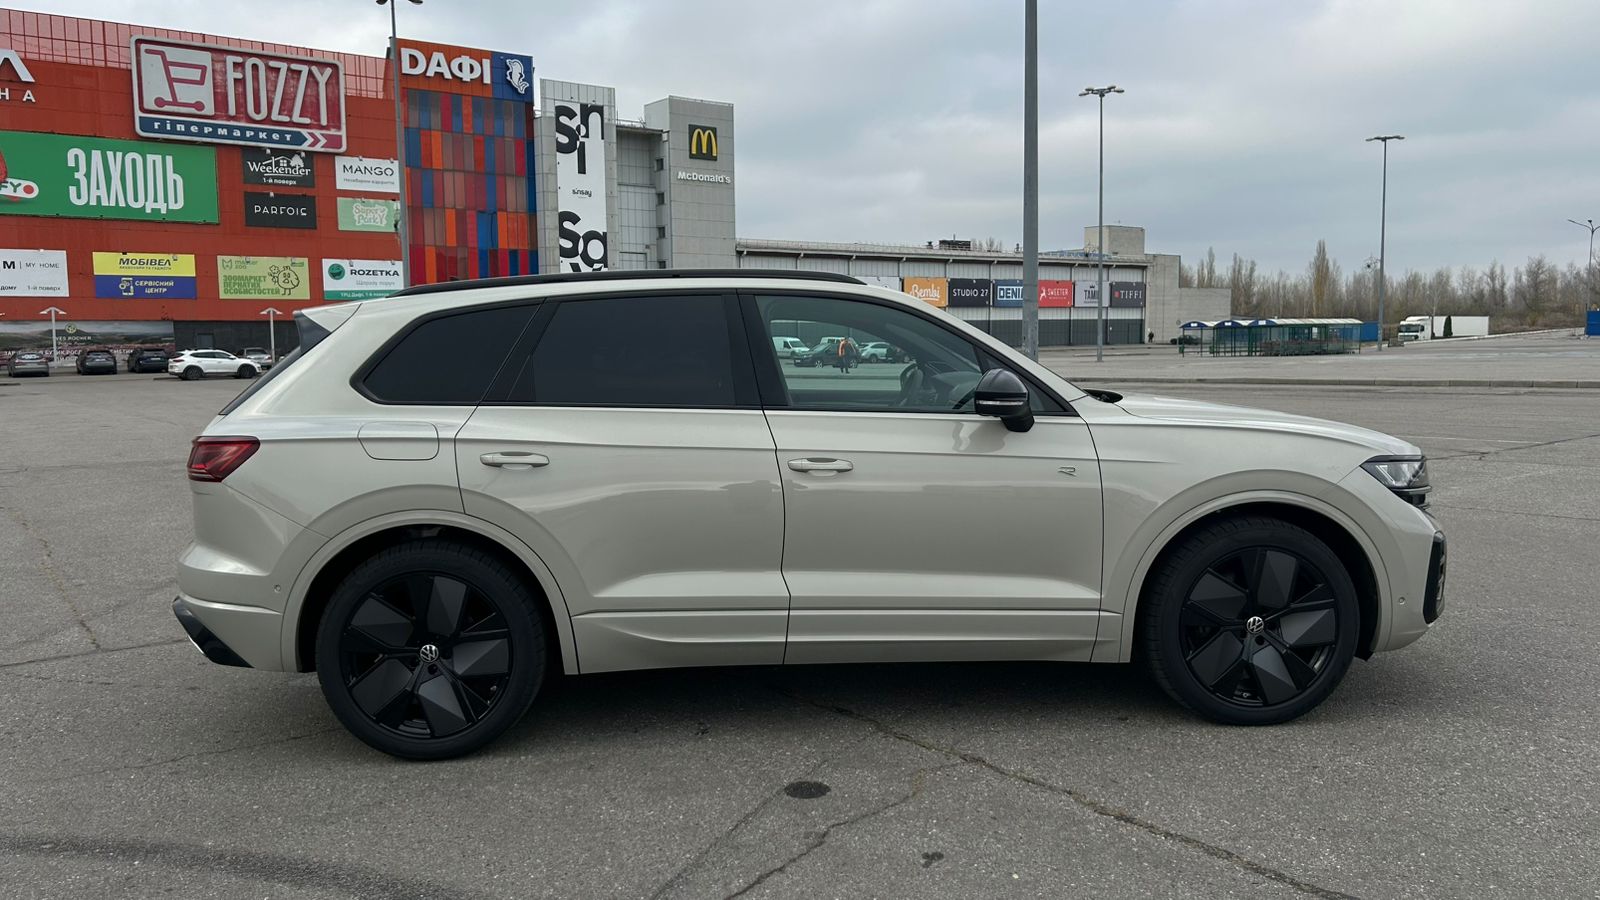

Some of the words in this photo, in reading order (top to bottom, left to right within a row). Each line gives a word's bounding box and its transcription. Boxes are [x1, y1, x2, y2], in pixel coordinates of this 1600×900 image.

[225, 55, 333, 126] FOZZY
[153, 120, 292, 142] гіпермаркет
[247, 157, 311, 176] Weekender
[343, 164, 394, 177] MANGO
[67, 148, 185, 214] ЗАХОДЬ
[677, 171, 731, 184] McDonald's
[572, 187, 592, 198] sinsay
[254, 205, 307, 216] PARFOIS
[119, 258, 172, 267] МОБІВЕЛ
[350, 269, 400, 277] ROZETKA
[224, 287, 281, 295] ОСОБИСТОСТЕЙ
[909, 283, 940, 299] Bembi
[952, 288, 978, 297] STUDIO
[980, 289, 989, 297] 27
[1120, 290, 1143, 299] TIFFI
